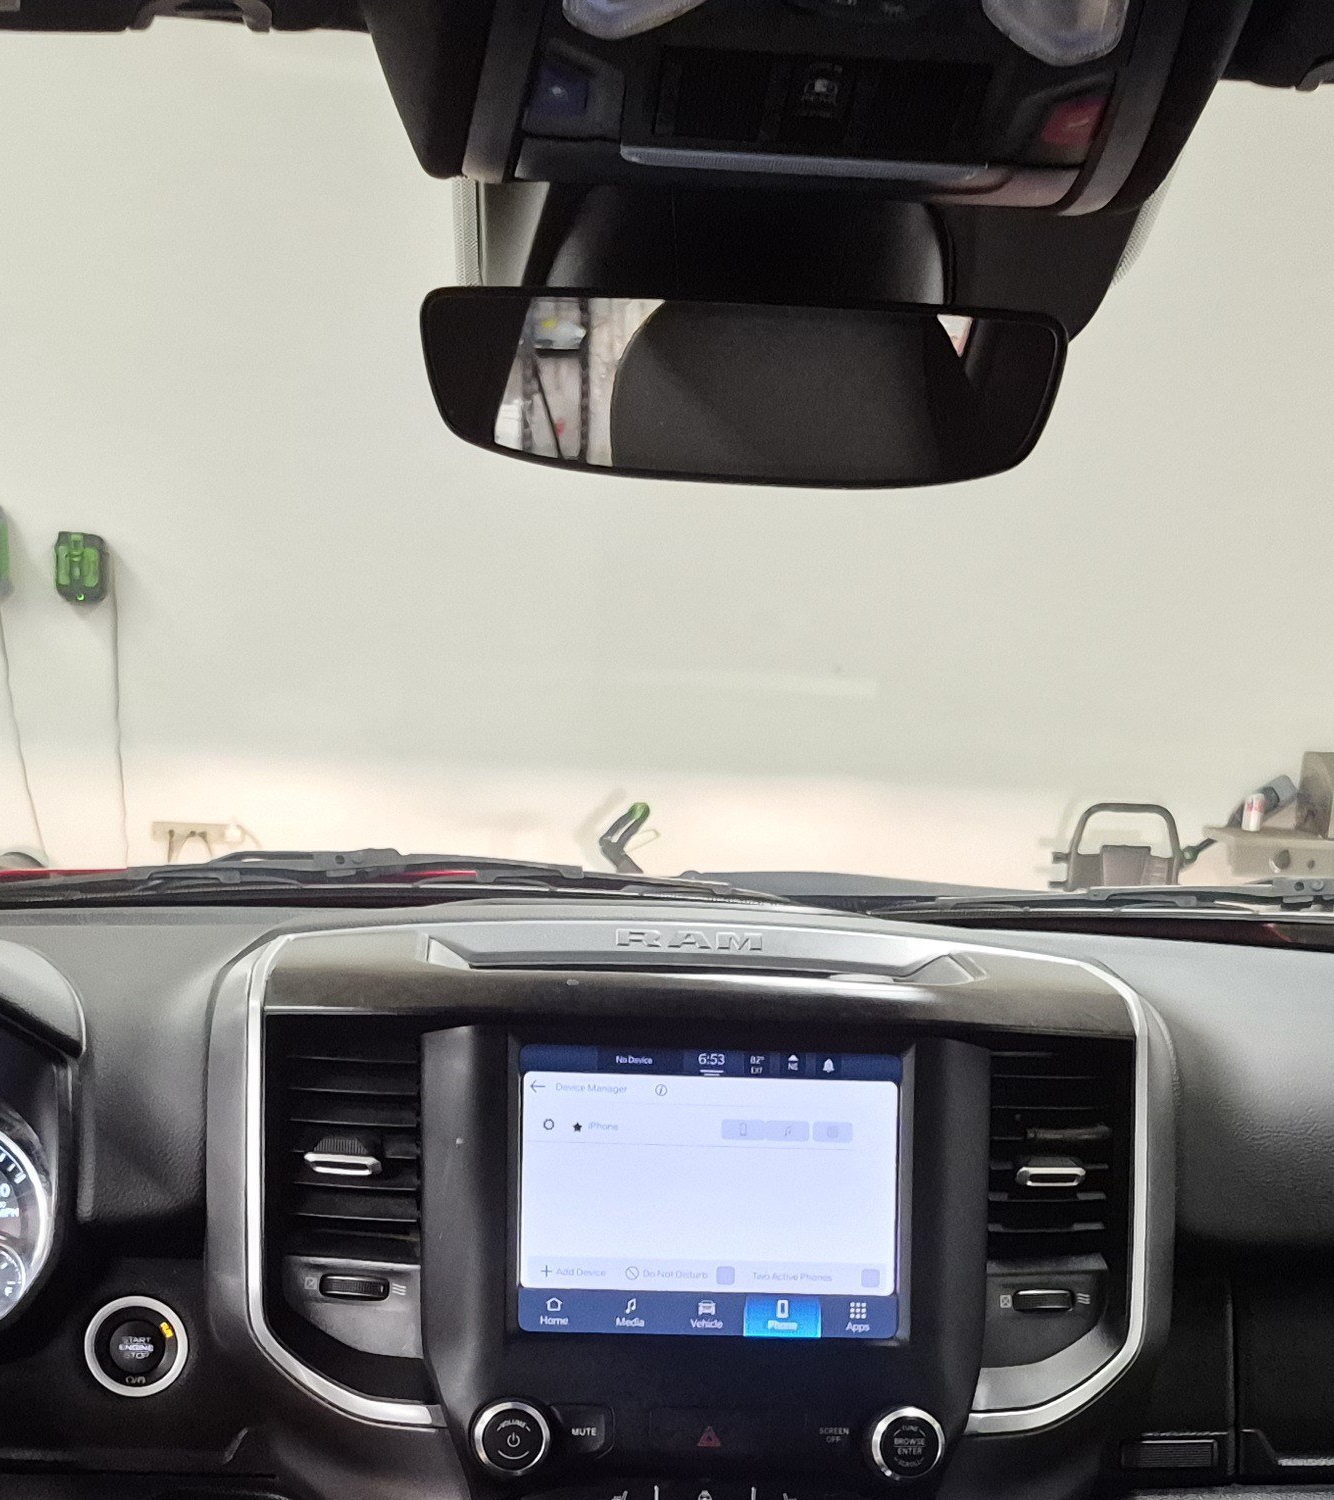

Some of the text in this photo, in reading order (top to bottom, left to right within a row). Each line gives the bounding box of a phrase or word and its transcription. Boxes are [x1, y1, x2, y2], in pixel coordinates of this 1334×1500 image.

[616, 928, 762, 951] RAM
[698, 1053, 725, 1066] 6:53
[555, 1082, 627, 1095] Device Manager
[589, 1121, 619, 1131] iPhone
[556, 1267, 606, 1278] Add Device
[643, 1268, 709, 1280] Do Not Disturb
[772, 1272, 799, 1282] Active
[800, 1273, 833, 1283] Phones
[540, 1315, 569, 1326] Home
[616, 1317, 645, 1328] Media
[690, 1318, 723, 1329] Vehicle
[767, 1320, 798, 1331] Phone
[845, 1322, 870, 1333] Apps
[122, 1335, 151, 1343] START
[118, 1343, 154, 1352] ENGINE
[571, 1427, 597, 1437] MUTE
[819, 1427, 850, 1435] SCREEN
[894, 1437, 925, 1446] BROWSE
